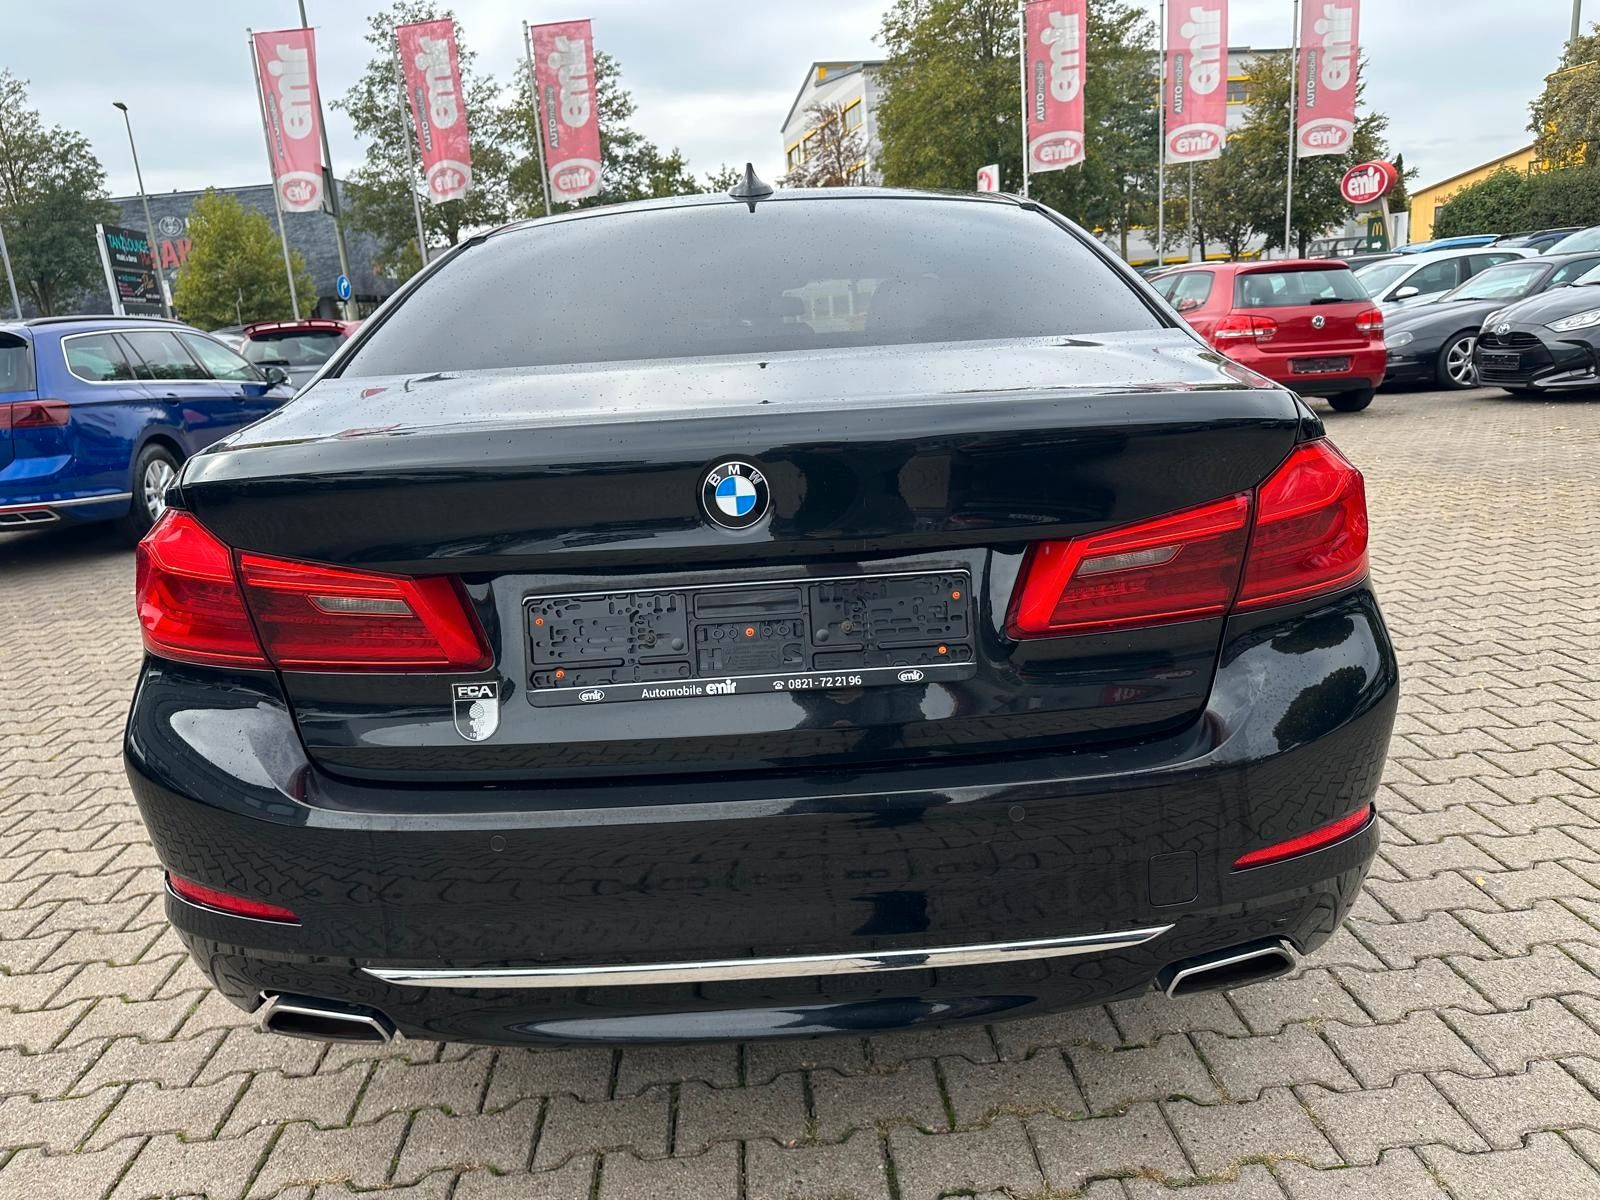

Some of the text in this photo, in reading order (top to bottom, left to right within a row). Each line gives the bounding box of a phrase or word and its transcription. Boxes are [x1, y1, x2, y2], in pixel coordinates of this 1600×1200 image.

[1040, 11, 1079, 102] emir
[1180, 6, 1220, 94] emir
[1314, 3, 1352, 90] emir
[267, 44, 313, 139] emir
[415, 36, 458, 129] emir
[548, 35, 590, 128] emir
[1176, 132, 1214, 153] emir
[1308, 127, 1342, 146] emir
[1040, 140, 1076, 162] emir
[558, 168, 591, 191] emir
[1347, 166, 1381, 197] emir
[708, 464, 763, 487] BMW
[457, 685, 493, 698] FCA
[641, 679, 737, 698] Automobile emir
